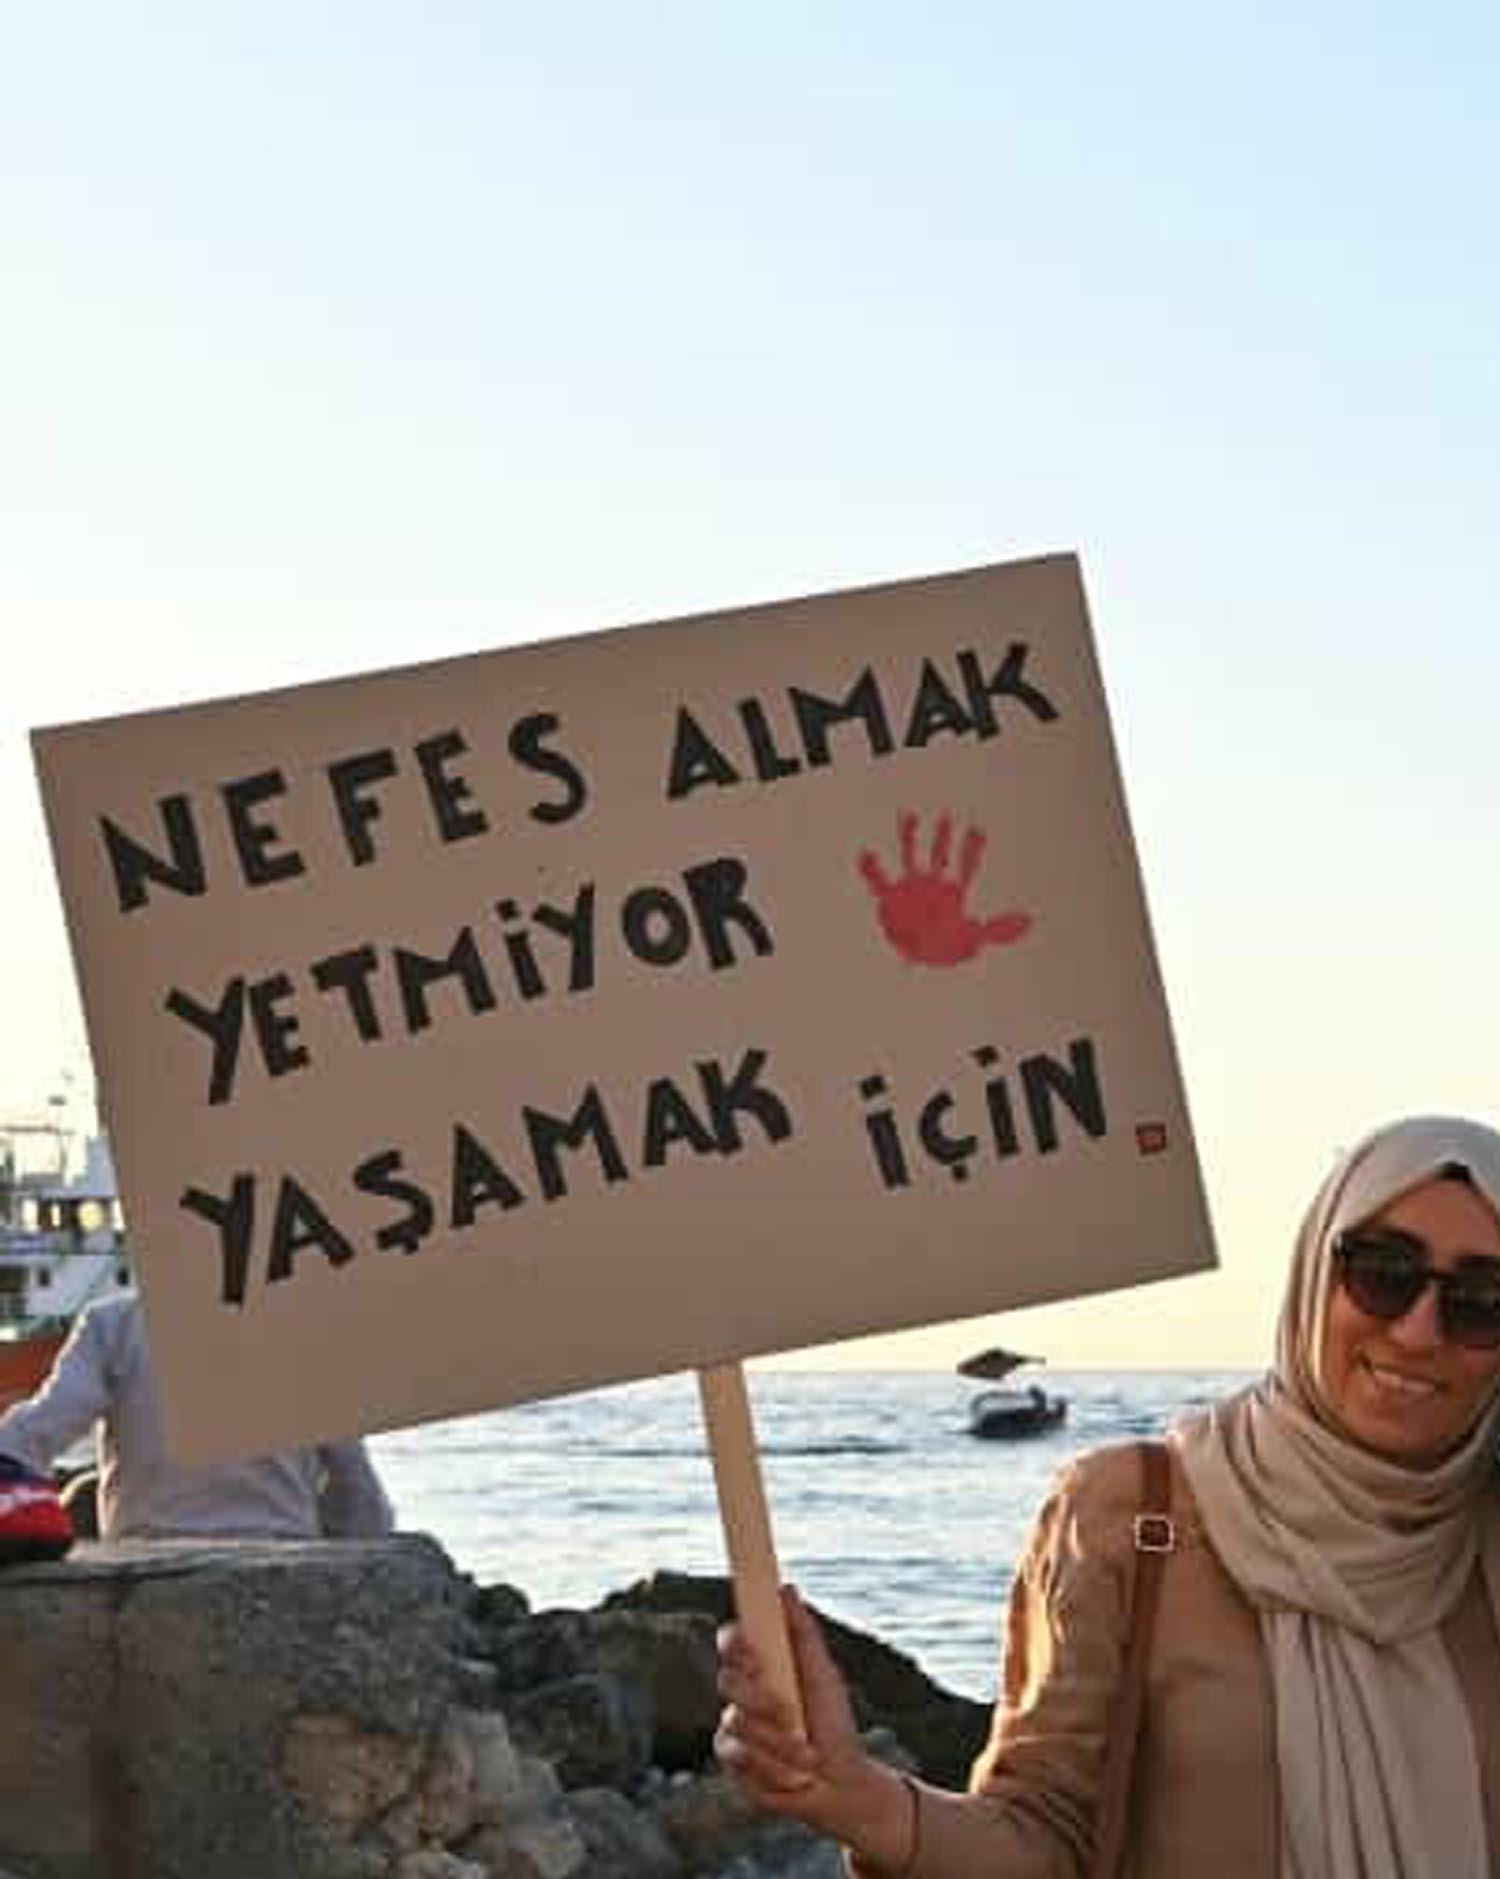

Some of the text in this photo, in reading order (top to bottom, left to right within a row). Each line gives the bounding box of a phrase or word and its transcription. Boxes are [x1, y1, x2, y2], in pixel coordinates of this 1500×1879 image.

[98, 641, 1062, 915] NEFES ALMAK
[178, 1047, 793, 1309] YAŞAMAK
